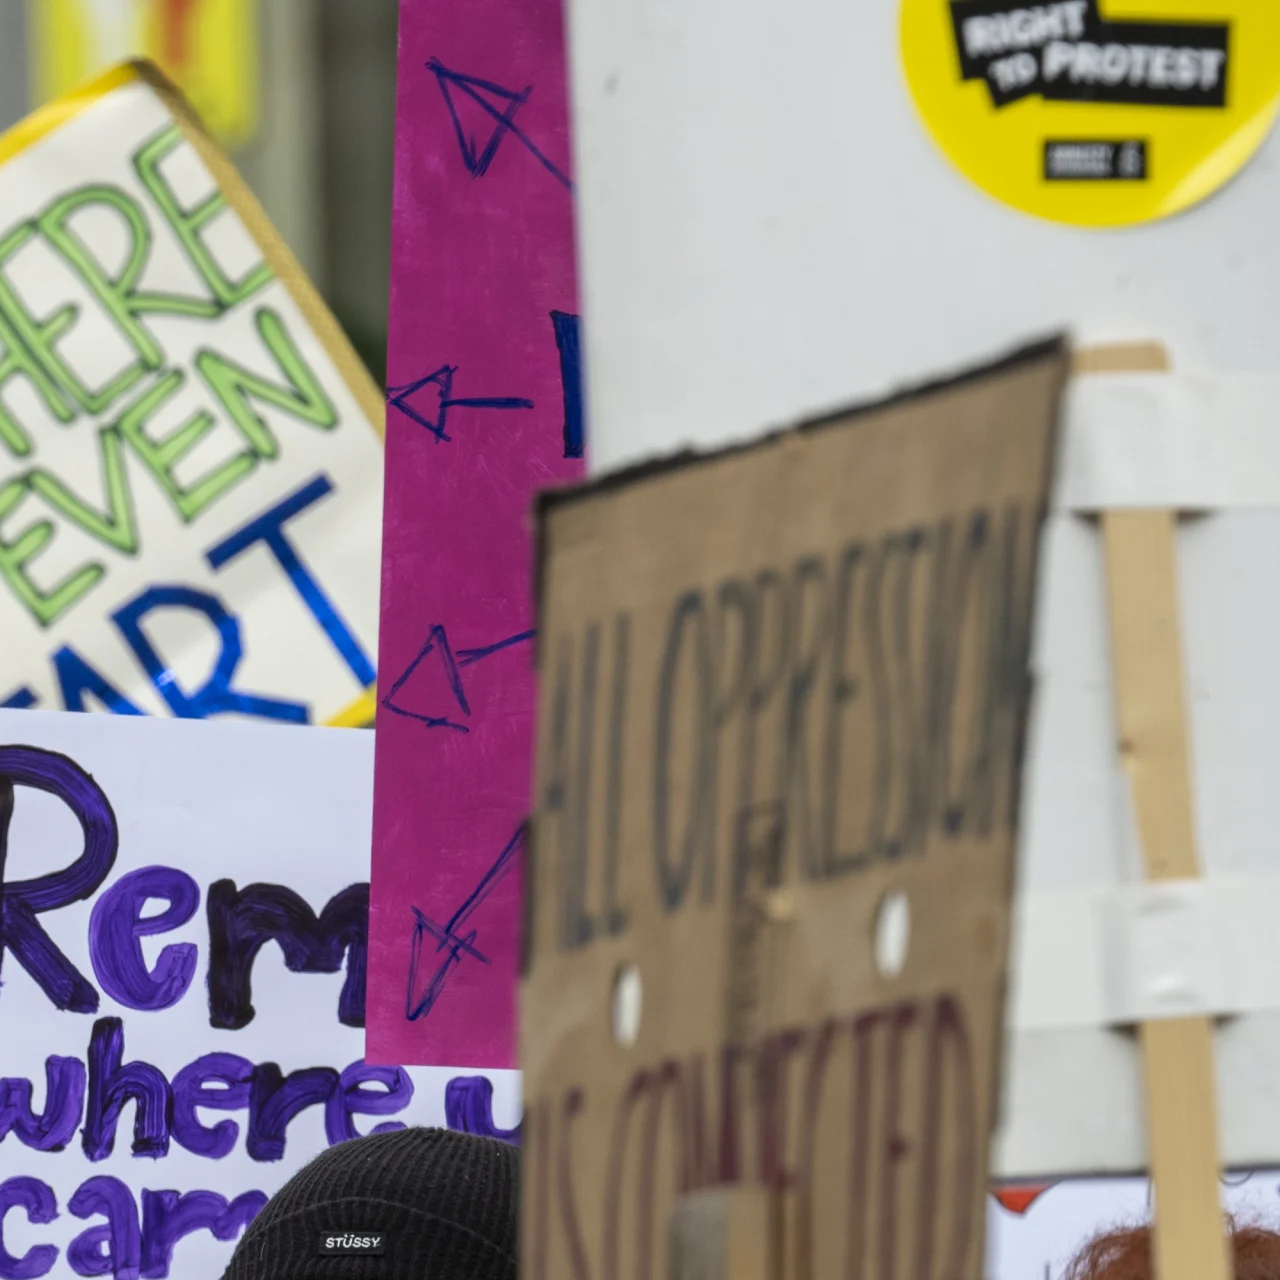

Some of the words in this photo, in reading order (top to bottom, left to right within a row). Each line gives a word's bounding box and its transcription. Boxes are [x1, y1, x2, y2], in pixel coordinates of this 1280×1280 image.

[962, 1, 1088, 57] RIGHT
[988, 51, 1039, 92] TO
[1042, 41, 1226, 91] PROTEST
[325, 1233, 381, 1249] STÜSSY
